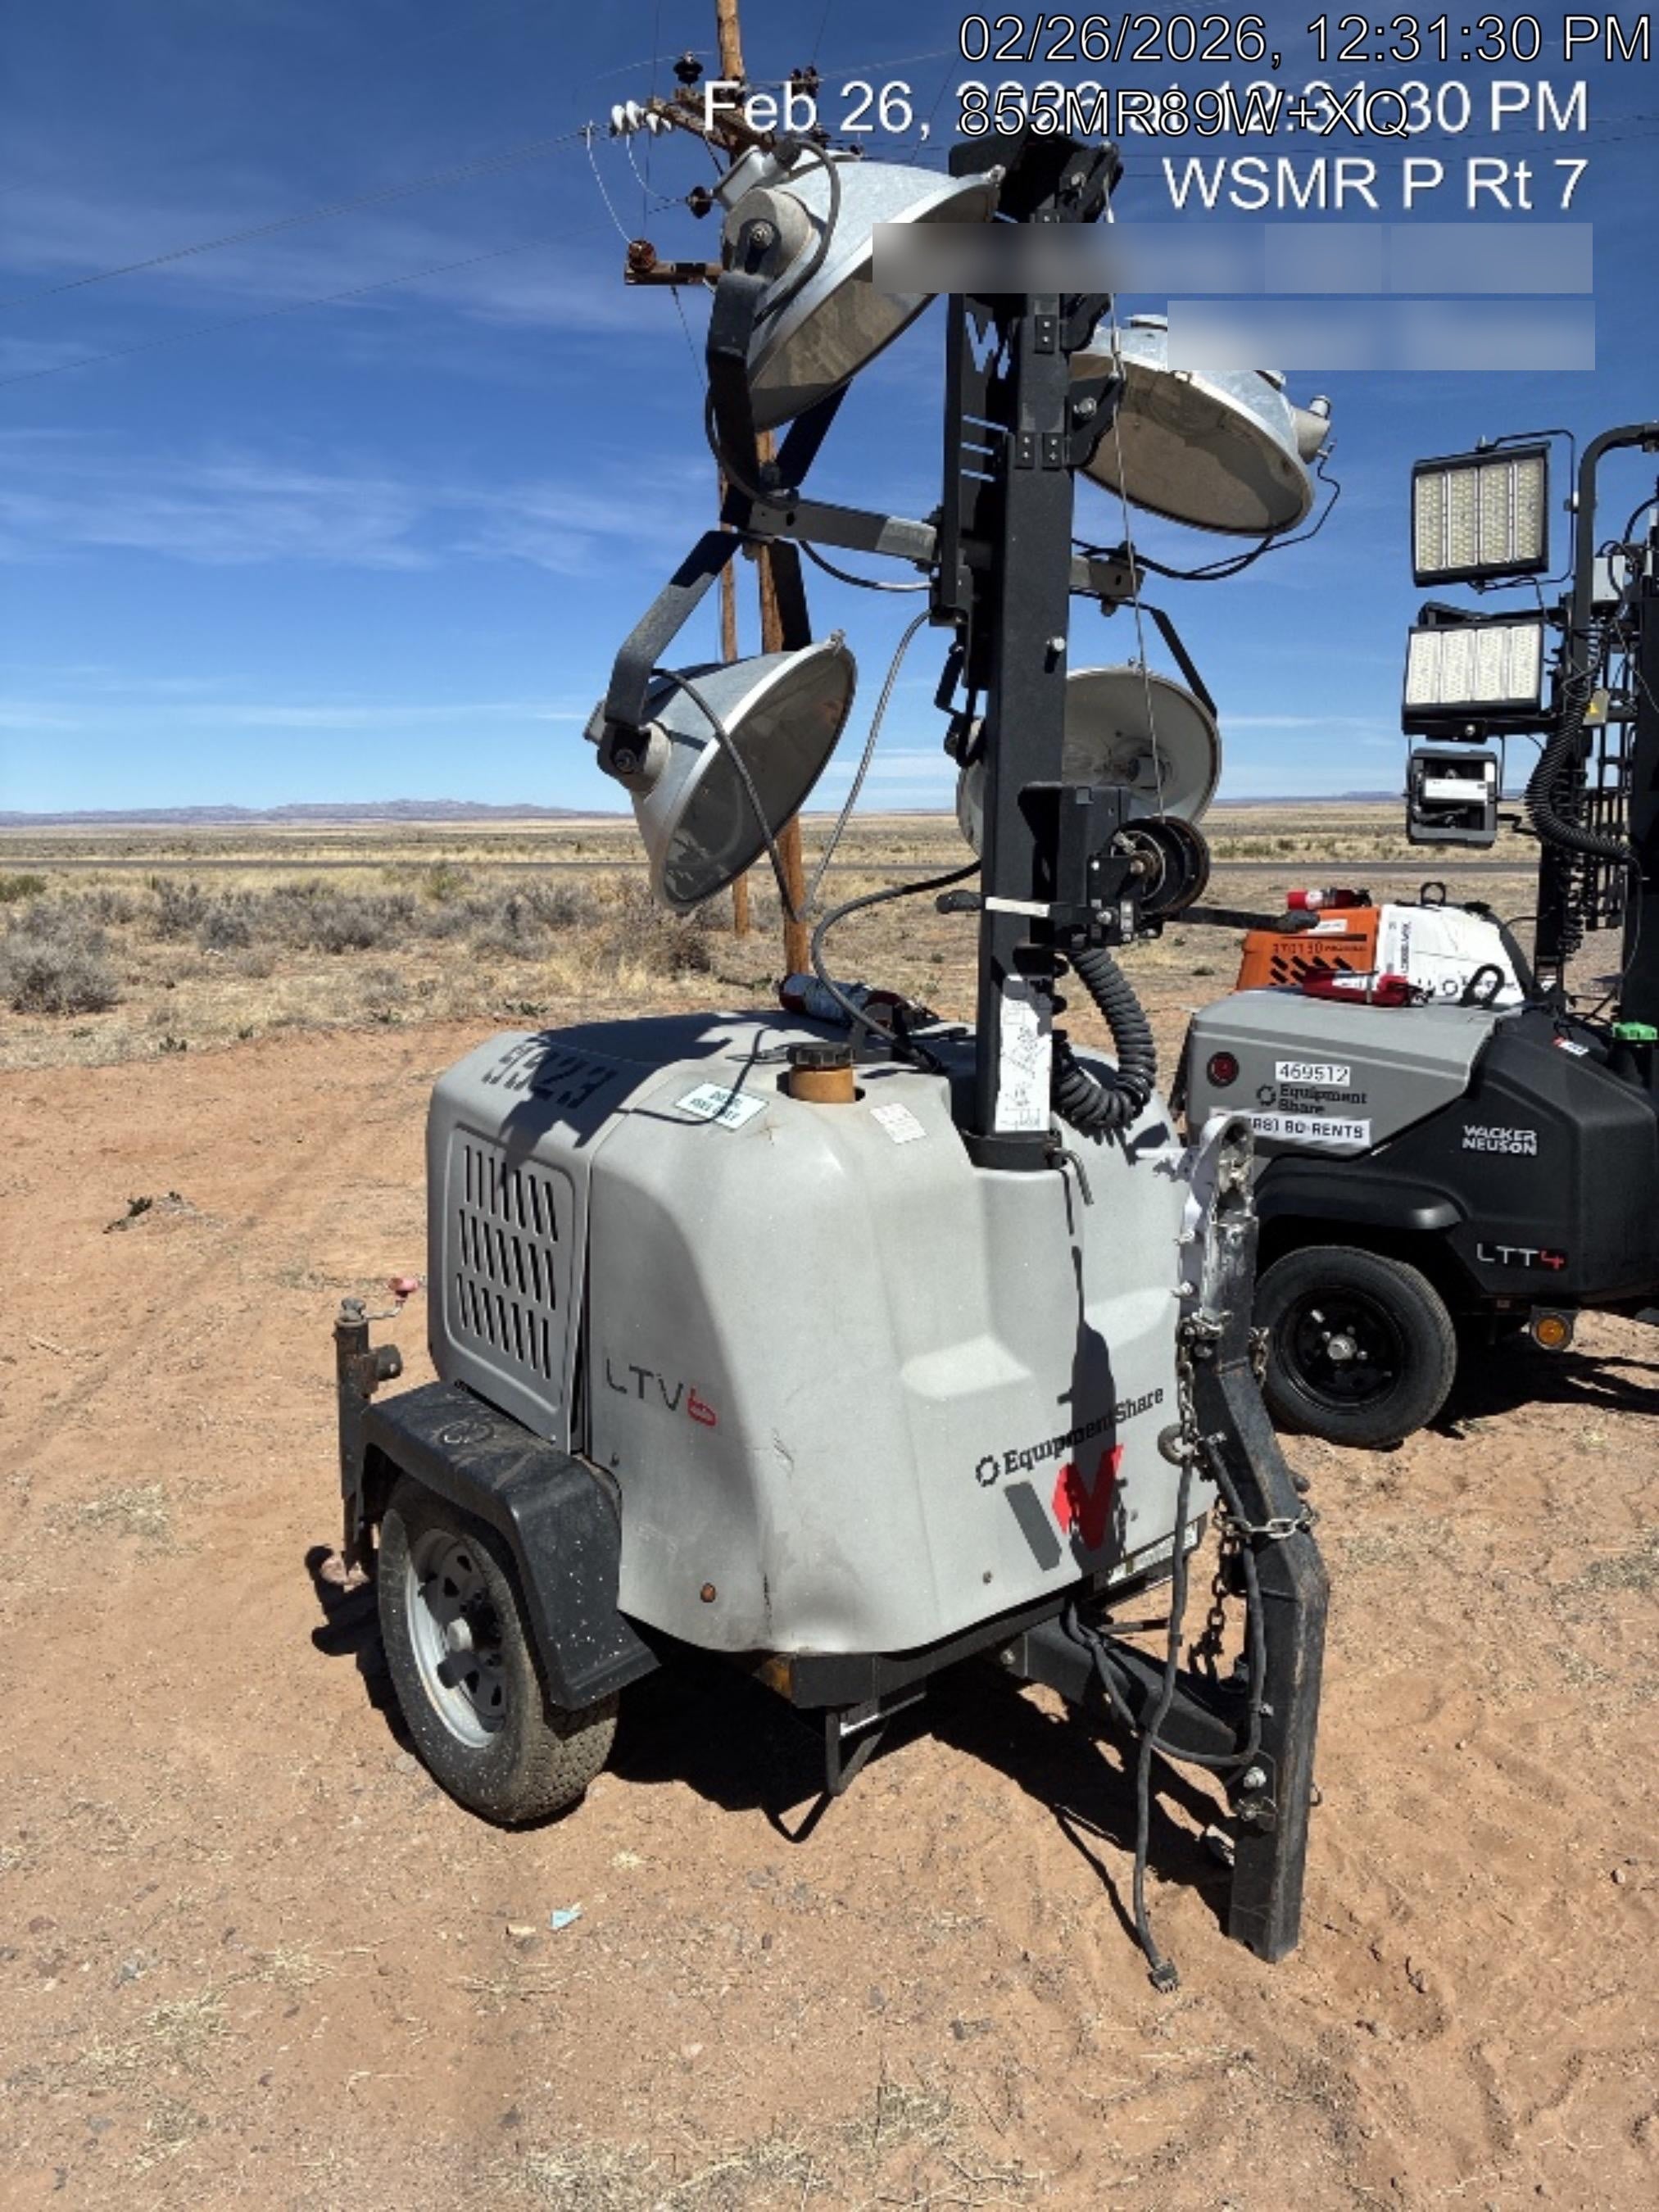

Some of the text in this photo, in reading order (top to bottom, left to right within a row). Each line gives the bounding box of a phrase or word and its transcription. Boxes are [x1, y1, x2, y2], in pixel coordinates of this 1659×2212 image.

[1279, 1064, 1348, 1082] 469512
[1280, 1084, 1367, 1104] Equipment
[1278, 1098, 1325, 1114] Share
[1463, 1125, 1537, 1142] WACKER
[1462, 1137, 1537, 1156] NEUSON
[1476, 1243, 1564, 1270] LTT4
[605, 1358, 717, 1426] LTV6
[1003, 1387, 1164, 1475] EquipmentShare
